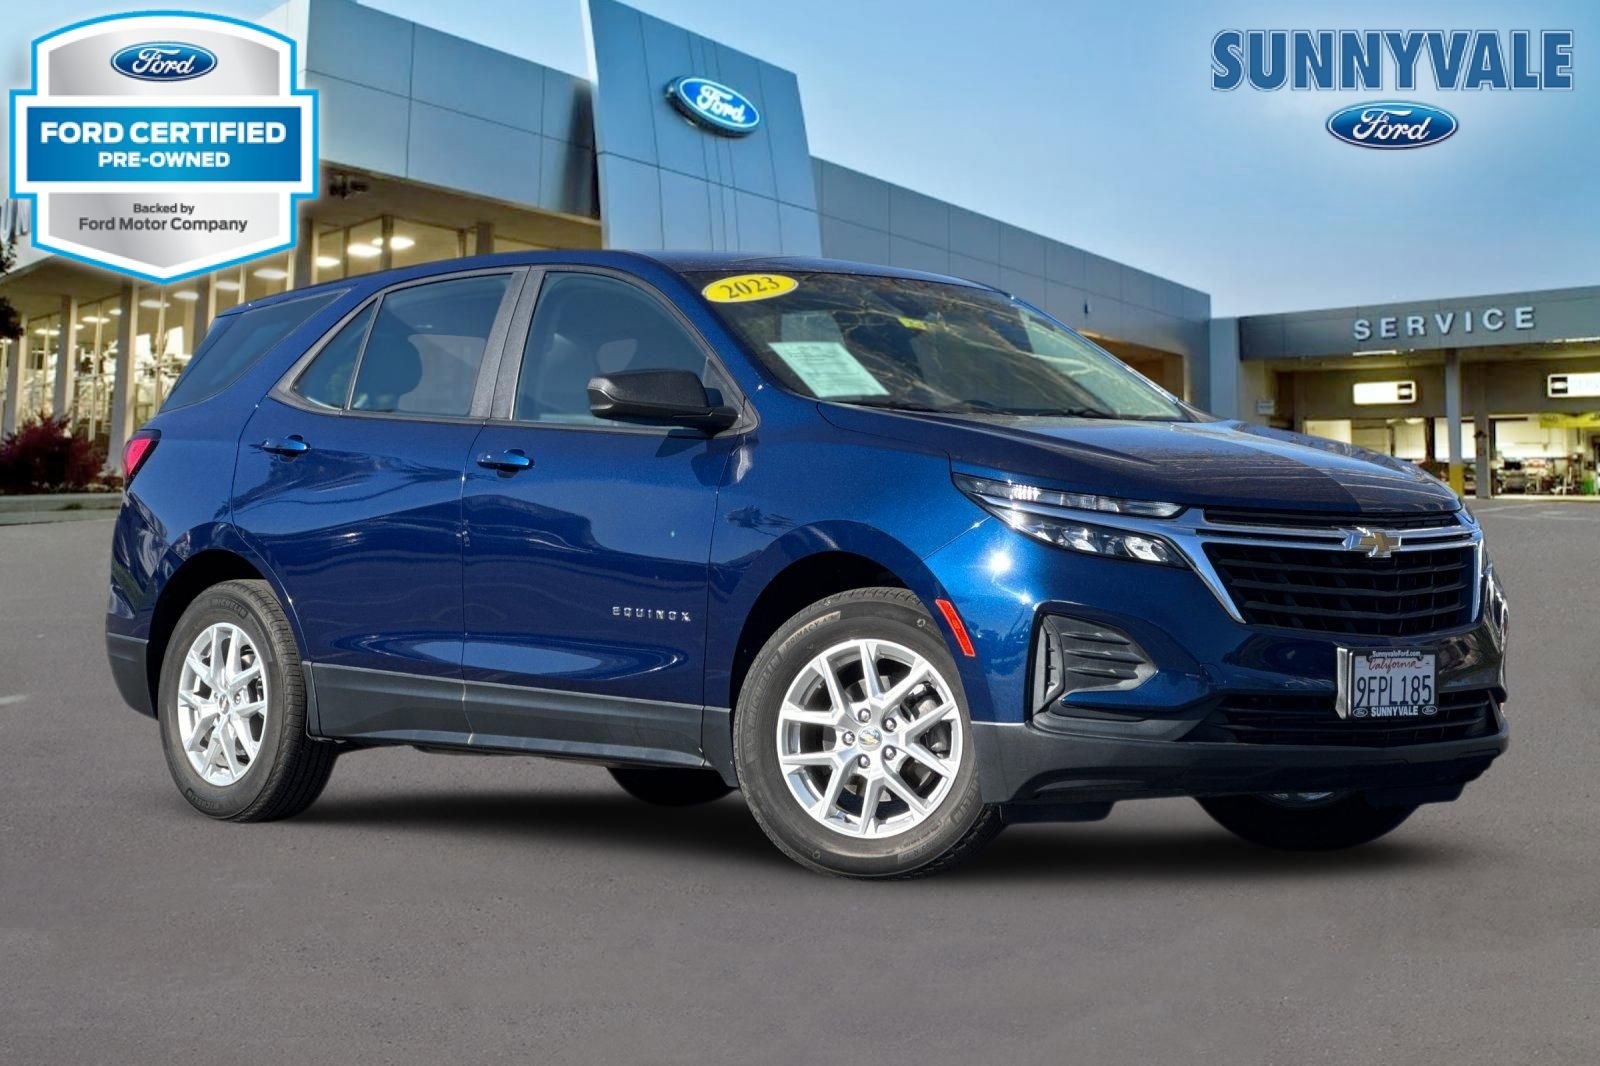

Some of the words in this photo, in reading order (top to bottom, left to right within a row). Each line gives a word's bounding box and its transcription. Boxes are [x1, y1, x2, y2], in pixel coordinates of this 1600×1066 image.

[696, 84, 746, 123] Ford
[719, 277, 780, 299] 2023
[1353, 306, 1536, 340] SERVICE
[612, 606, 691, 622] EQUINOX
[1368, 658, 1422, 674] California
[1356, 675, 1432, 707] 9FPL185
[1371, 705, 1419, 717] SUNNYVALE
